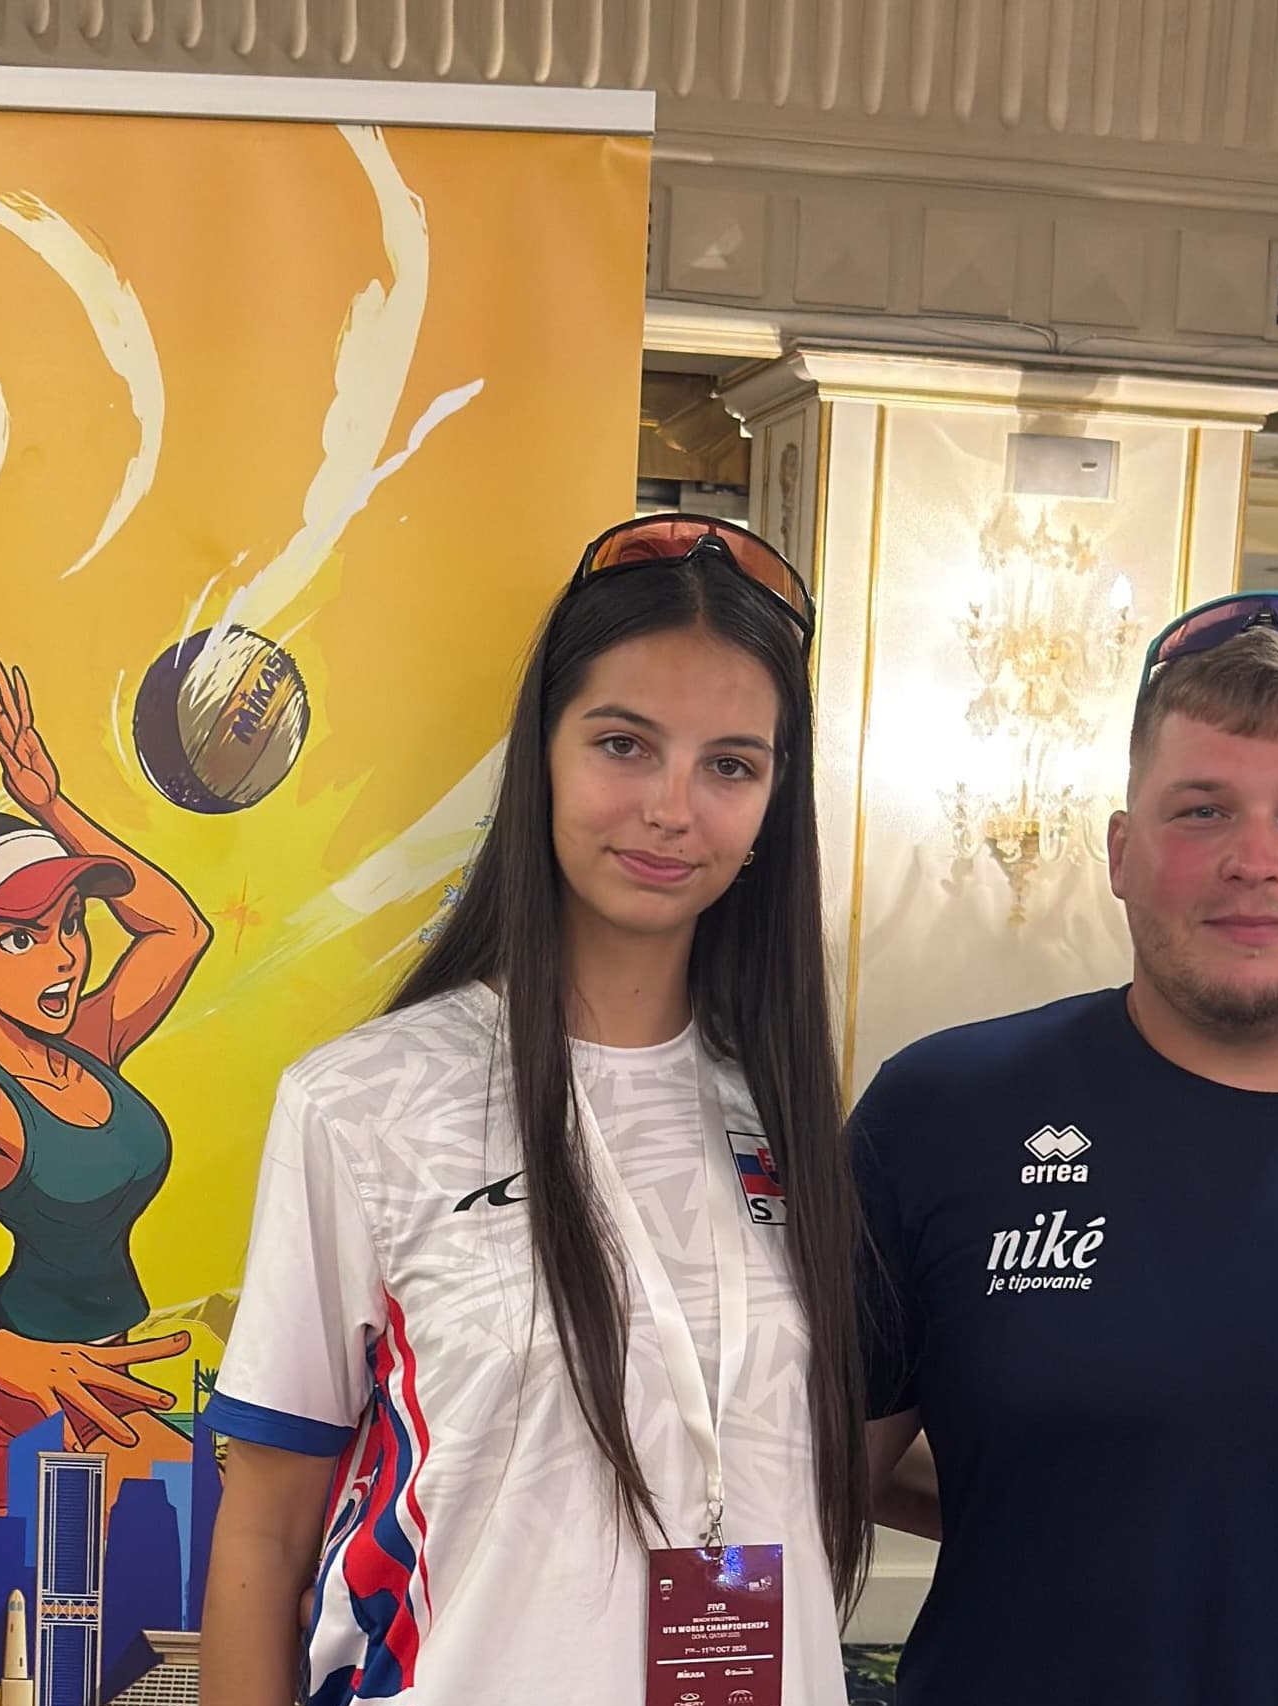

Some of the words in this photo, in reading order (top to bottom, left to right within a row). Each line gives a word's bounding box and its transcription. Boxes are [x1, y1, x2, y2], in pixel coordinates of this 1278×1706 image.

[986, 1210, 1106, 1270] niké
[986, 1275, 1005, 1295] je
[1008, 1273, 1093, 1293] tipovanie
[707, 1602, 726, 1611] FIVB
[662, 1626, 677, 1634] U18
[678, 1624, 704, 1633] WORLD
[706, 1621, 769, 1631] CHAMPIONSHIPS
